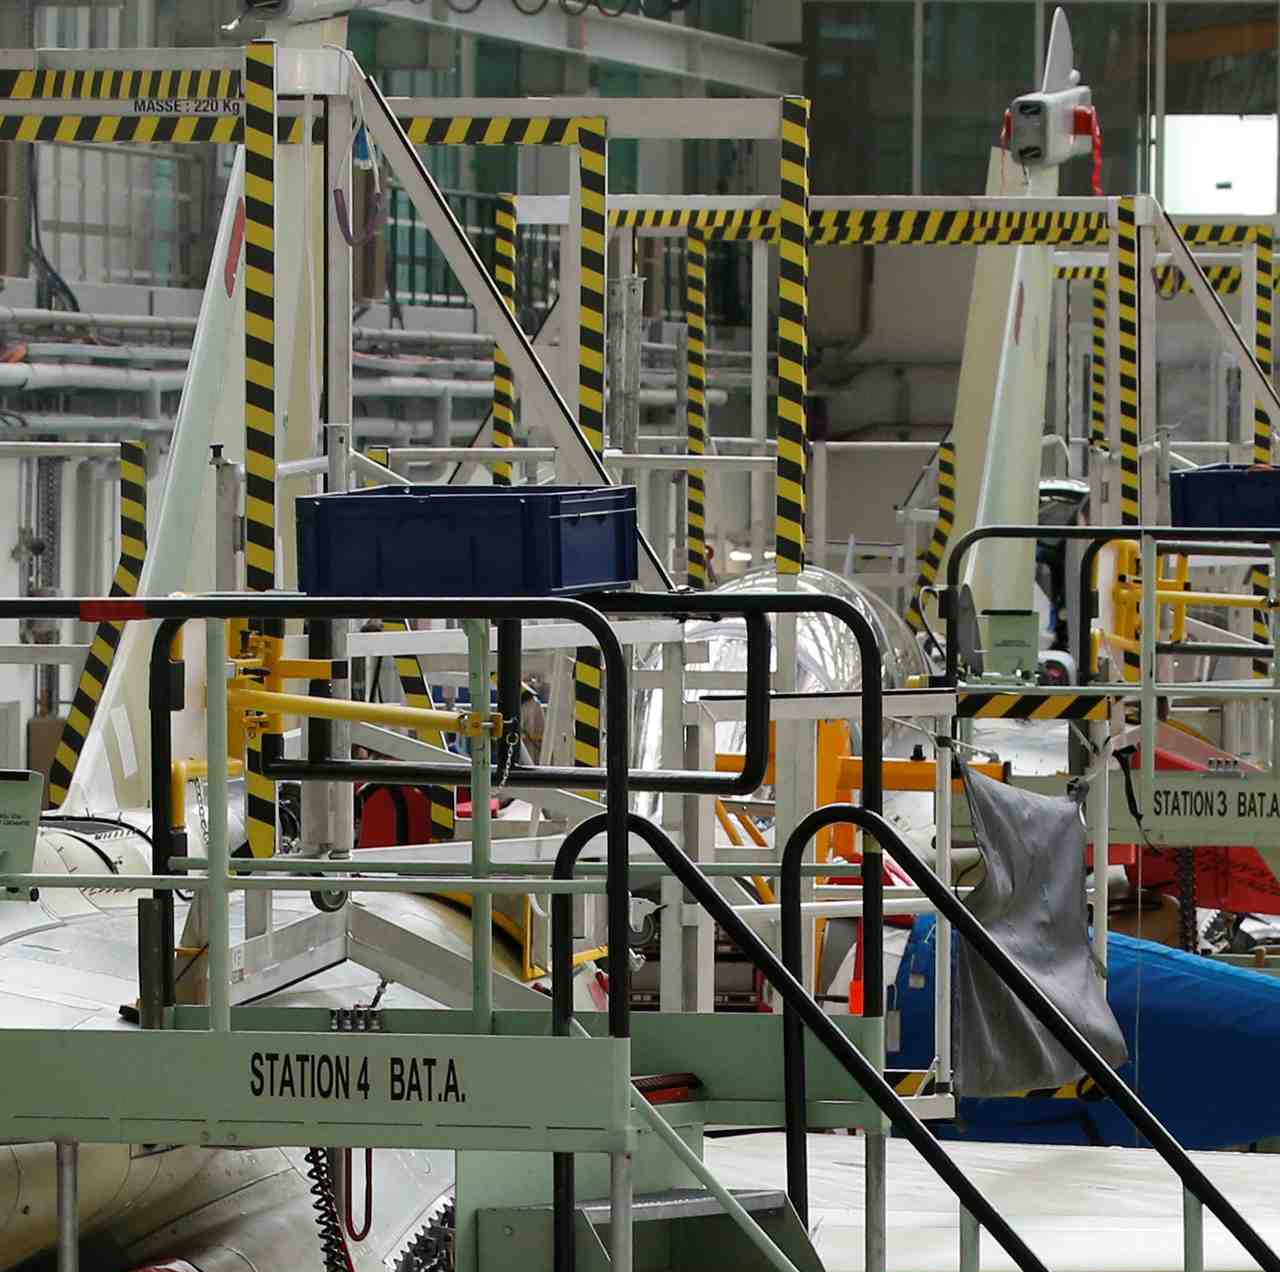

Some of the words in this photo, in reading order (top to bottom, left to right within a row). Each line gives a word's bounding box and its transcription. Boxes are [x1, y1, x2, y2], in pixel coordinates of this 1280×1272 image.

[133, 100, 181, 113] MASSE
[194, 100, 219, 113] 220
[223, 100, 240, 116] Kg
[1153, 789, 1214, 817] STATION
[1217, 790, 1227, 817] 3
[250, 1052, 349, 1100] STATION
[357, 1056, 370, 1100] 4
[390, 1057, 466, 1102] BAT.A.
